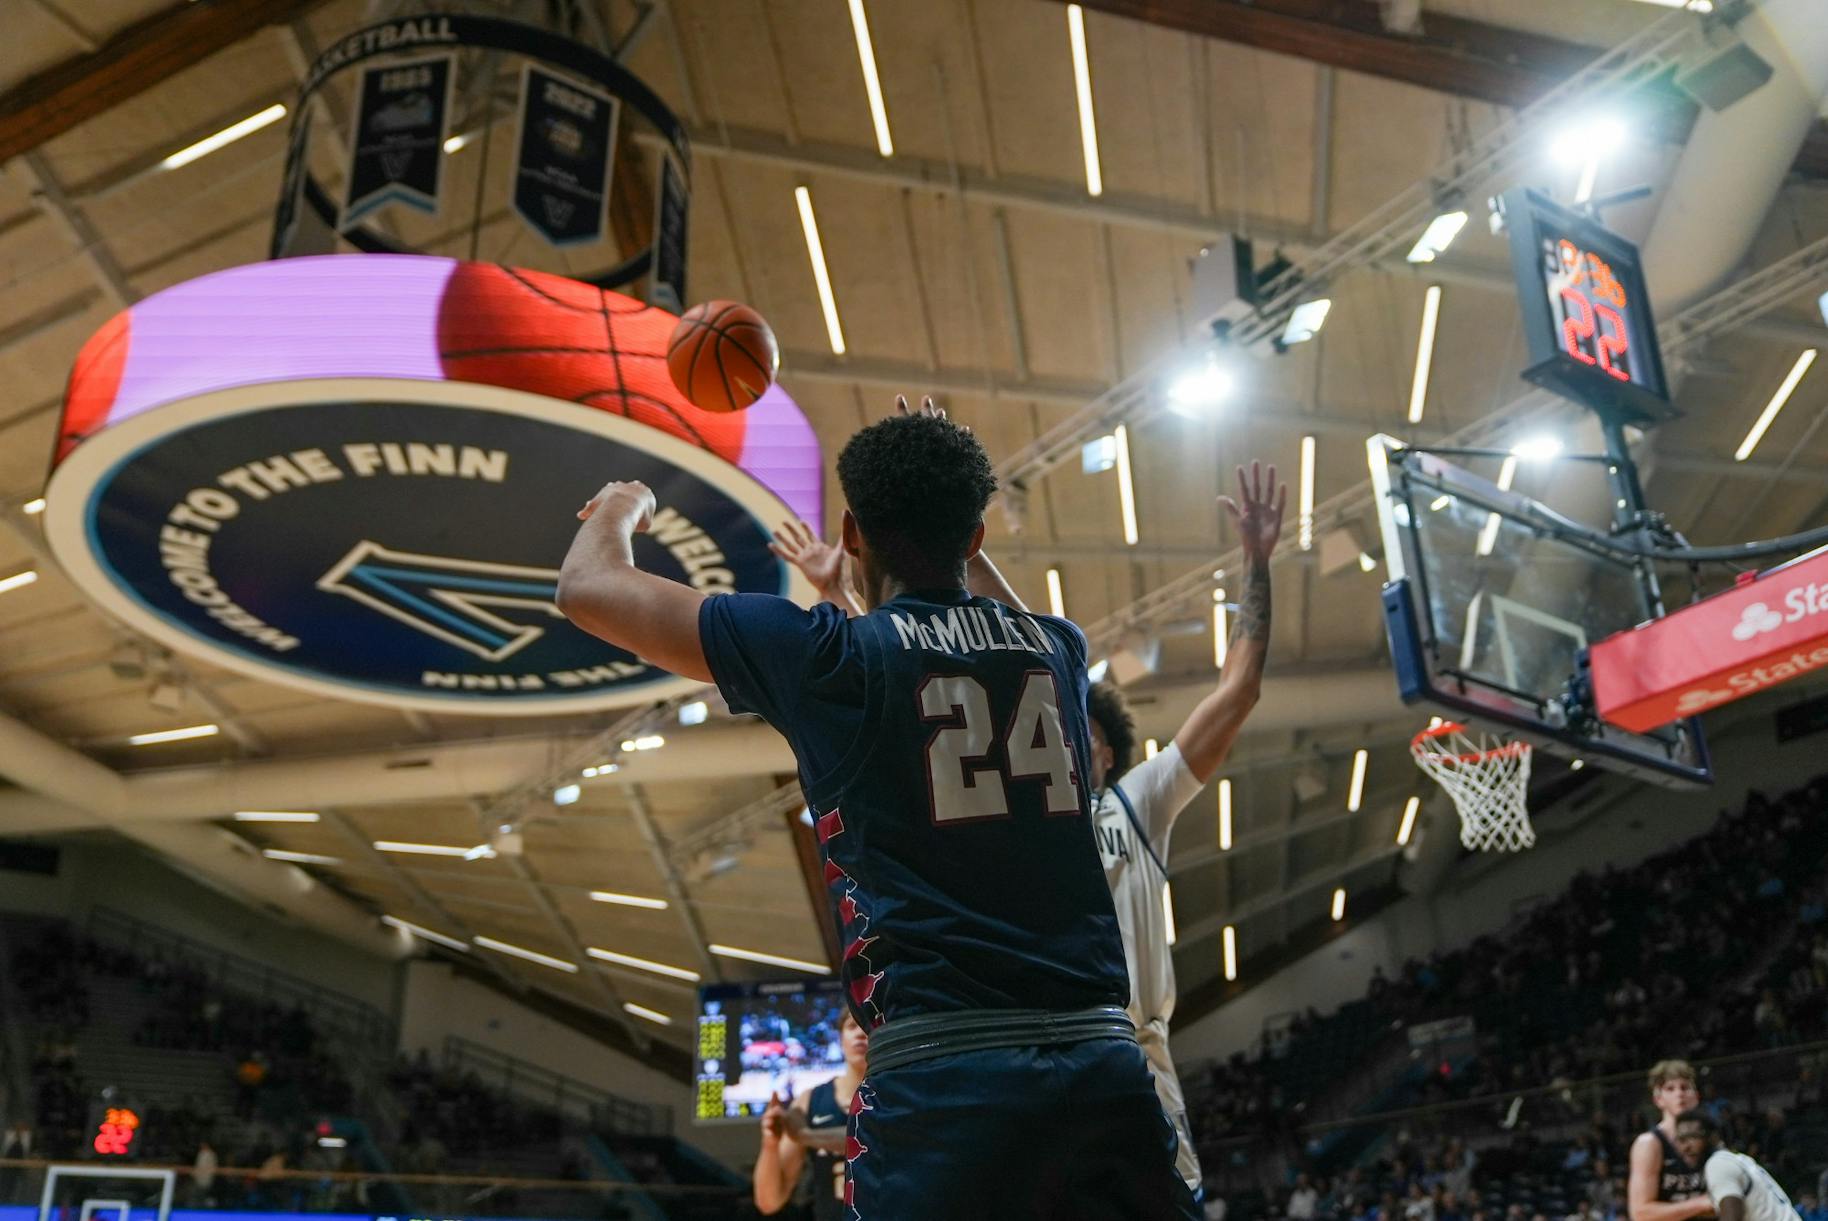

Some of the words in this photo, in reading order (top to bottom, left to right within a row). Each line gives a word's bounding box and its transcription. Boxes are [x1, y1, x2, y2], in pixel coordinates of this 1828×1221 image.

[1560, 287, 1630, 381] 22
[217, 448, 344, 500] THE
[342, 442, 508, 483] FINN
[169, 488, 240, 532] TO
[159, 524, 301, 652] WELCOME
[421, 670, 546, 691] FINN
[547, 661, 647, 687] THE
[1728, 647, 1828, 691] State
[915, 669, 1081, 826] 24
